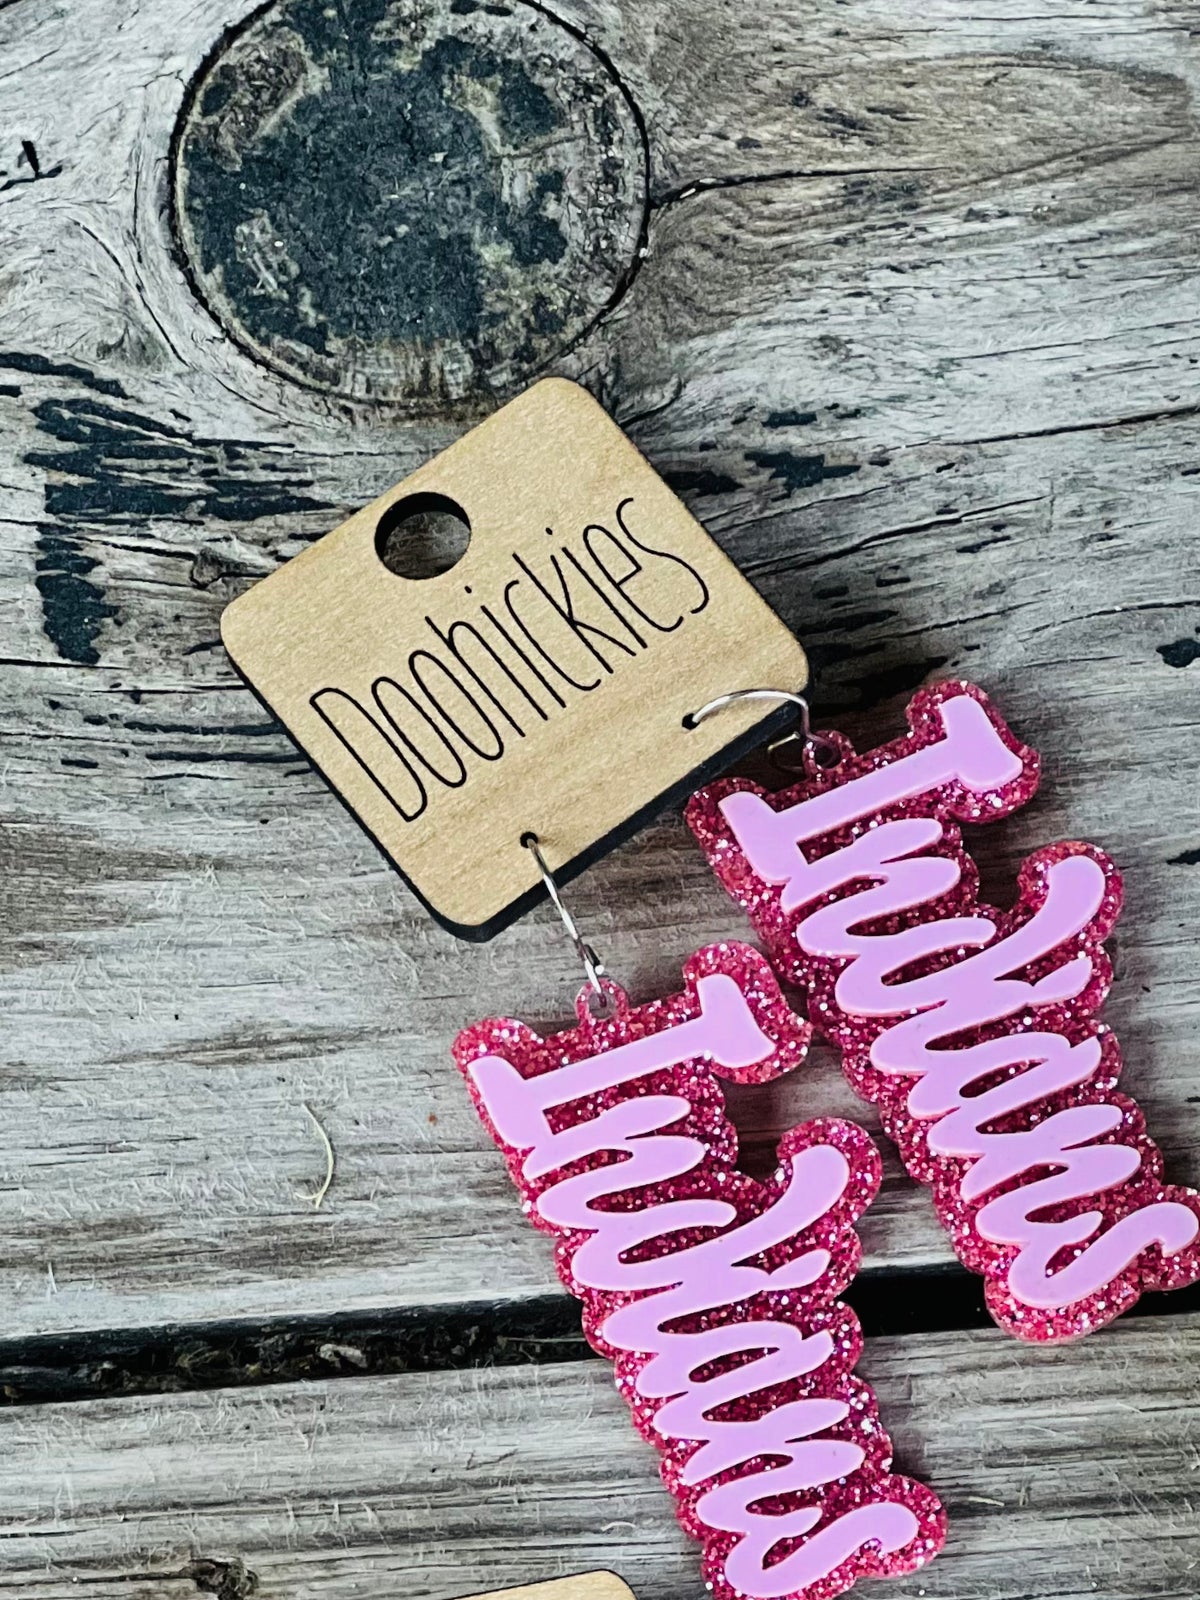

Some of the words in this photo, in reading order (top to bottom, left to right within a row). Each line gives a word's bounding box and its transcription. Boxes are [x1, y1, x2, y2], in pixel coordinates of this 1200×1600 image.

[309, 496, 710, 823] Doohickies
[469, 975, 918, 1599] Indians
[718, 694, 1198, 1308] Indians
